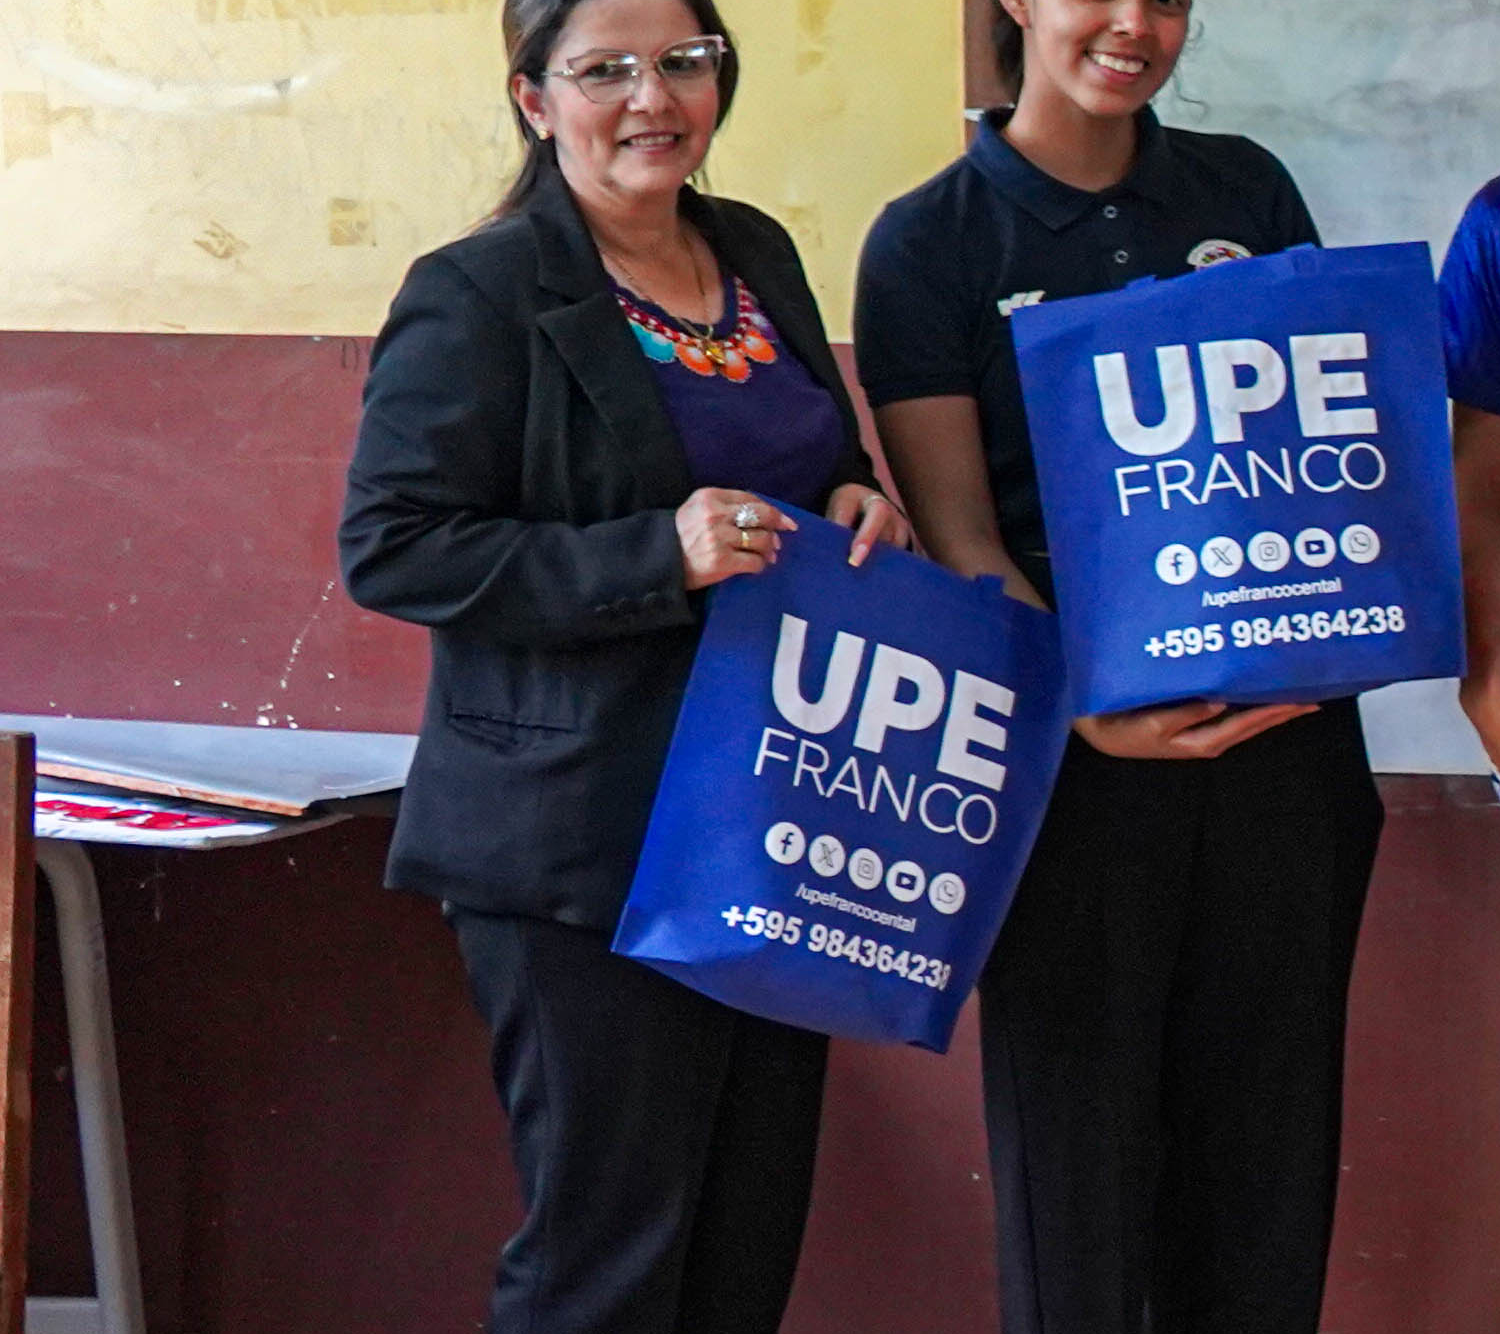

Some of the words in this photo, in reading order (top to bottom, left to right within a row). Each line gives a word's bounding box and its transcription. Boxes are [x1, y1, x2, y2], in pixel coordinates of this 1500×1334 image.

[1094, 332, 1379, 456] UPE
[1115, 441, 1387, 517] FRANCO
[1144, 624, 1224, 659] +595
[1232, 605, 1406, 648] 984364238
[772, 612, 1016, 792] UPE
[753, 726, 997, 845] FRANCO
[721, 904, 802, 946] +595
